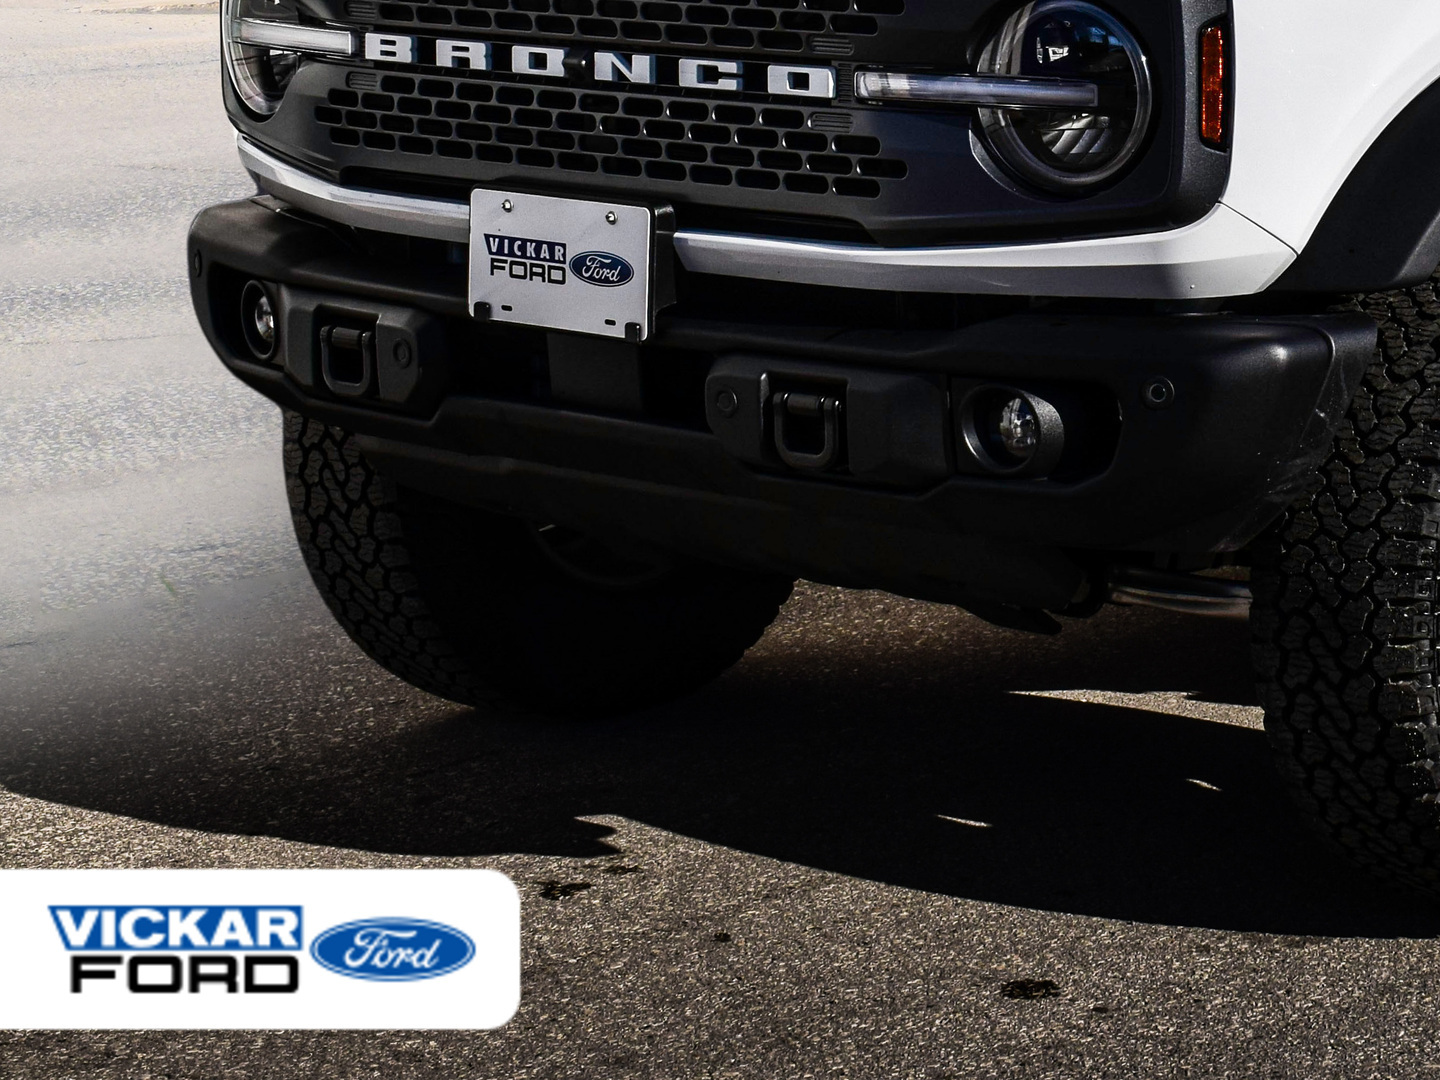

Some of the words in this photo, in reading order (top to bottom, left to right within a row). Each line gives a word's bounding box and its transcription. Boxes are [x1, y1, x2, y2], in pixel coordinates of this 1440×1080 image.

[364, 31, 836, 99] BRONCO
[489, 237, 565, 261] VICKAR
[490, 257, 567, 285] FORD
[582, 255, 621, 282] Ford
